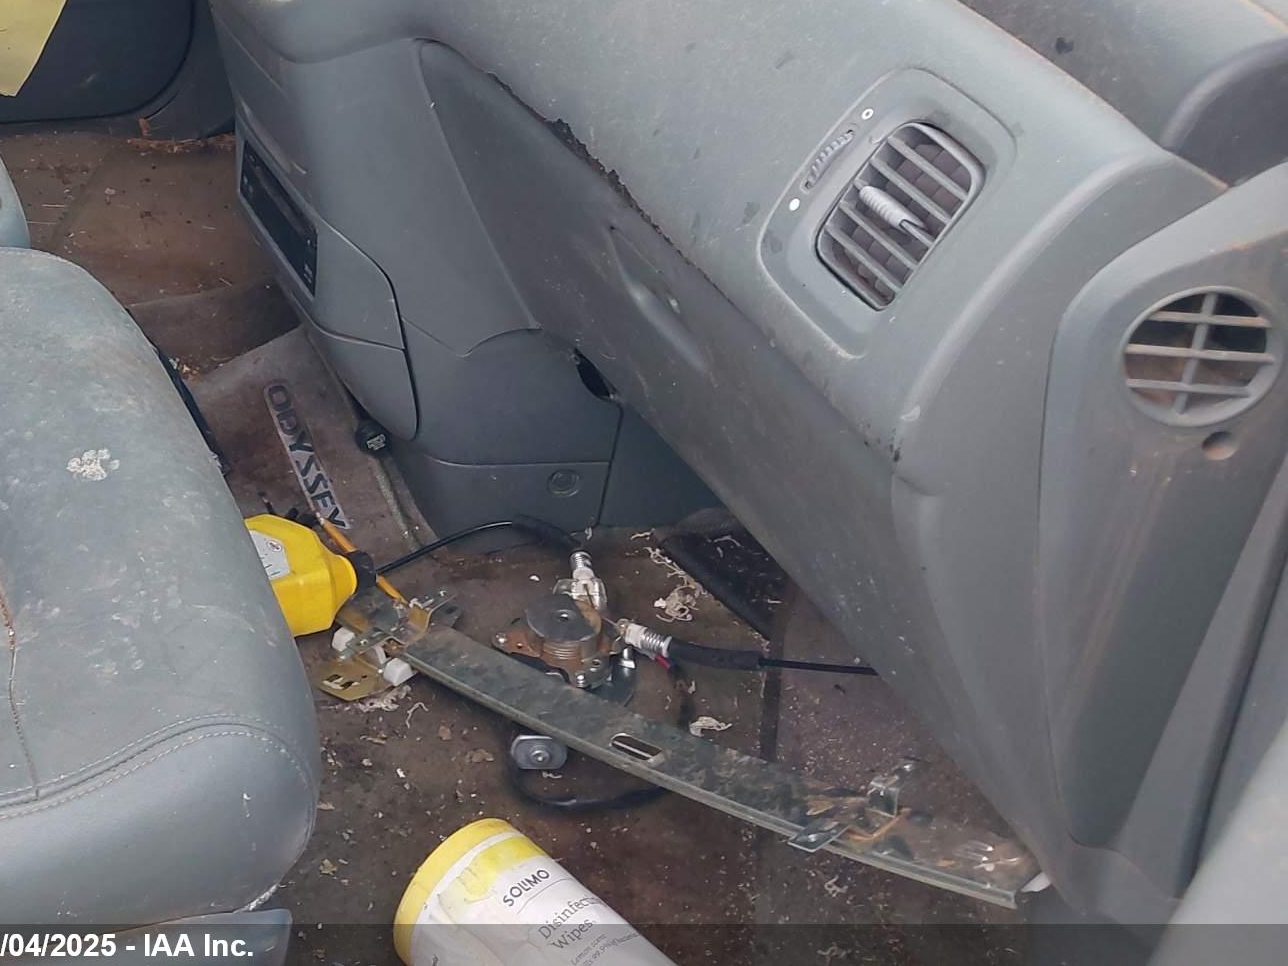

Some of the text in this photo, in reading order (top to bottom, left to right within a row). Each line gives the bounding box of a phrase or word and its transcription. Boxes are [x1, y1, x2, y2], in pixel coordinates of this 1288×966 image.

[268, 385, 346, 527] ODYSSEY
[502, 869, 550, 907] SOLIMO
[552, 918, 594, 950] Wipes
